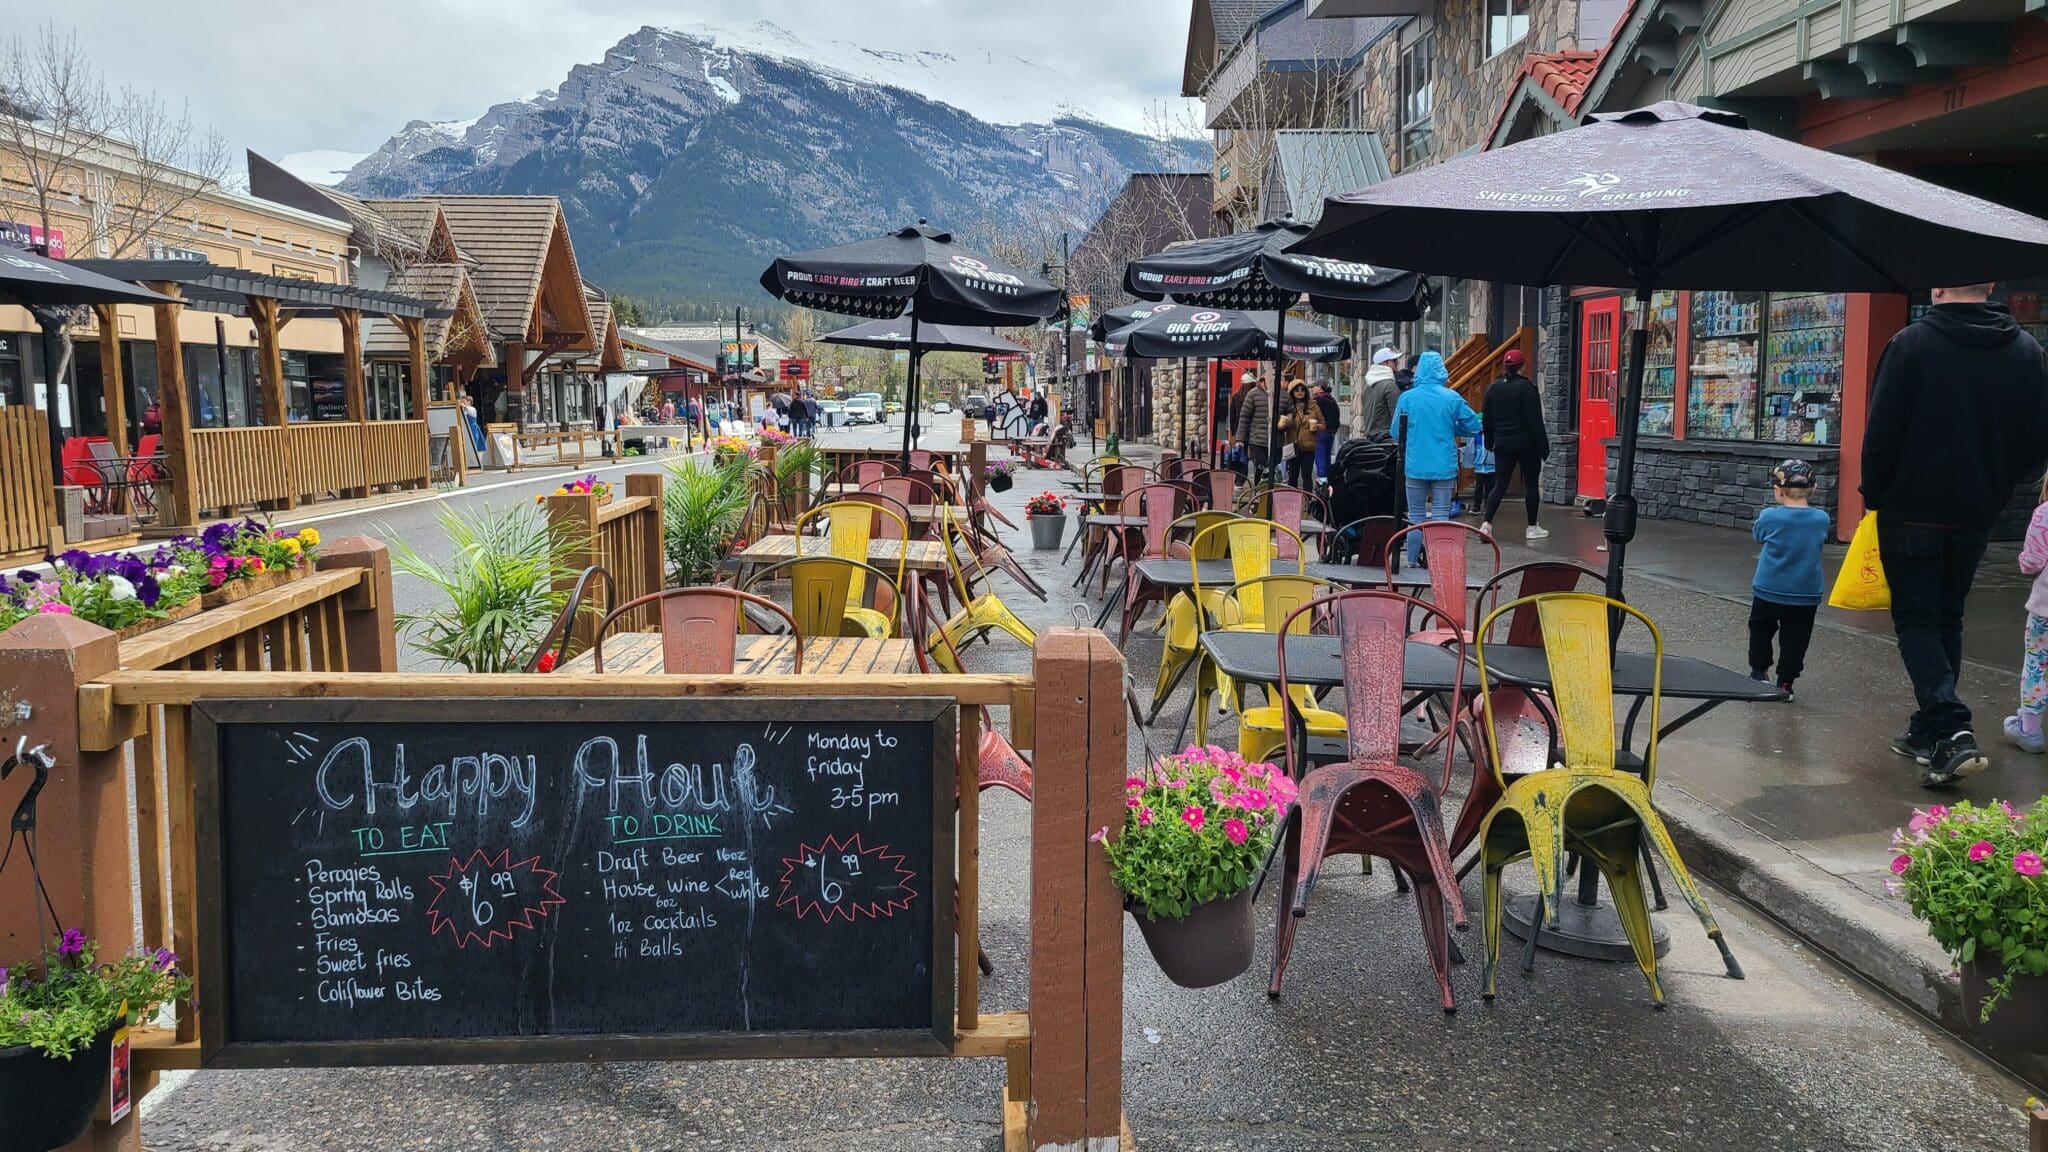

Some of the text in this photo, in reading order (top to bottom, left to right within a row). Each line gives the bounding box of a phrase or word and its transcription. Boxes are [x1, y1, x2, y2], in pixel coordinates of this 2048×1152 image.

[1474, 188, 1692, 202] SHEEPDOG BREWING
[787, 271, 814, 282] PROUD
[815, 274, 838, 285] EARLY
[839, 276, 859, 287] BIRD
[866, 276, 892, 287] CRAFT
[894, 275, 916, 286] BEER
[1139, 271, 1163, 282] PROUD
[1164, 274, 1187, 284] EARLY
[1188, 276, 1207, 285] BIRD
[1232, 266, 1249, 279] BEER
[1307, 267, 1368, 283] BREWERY
[1324, 262, 1375, 276] ROCK
[965, 279, 1018, 296] BREWERY
[1130, 310, 1152, 319] BIG
[1166, 321, 1231, 334] BIG ROCK
[1171, 334, 1221, 342] BREWERY
[808, 729, 897, 758] Monday to
[316, 734, 774, 828] Happy Hour
[830, 787, 898, 821] 3-5 pm
[605, 813, 721, 836] TO DRINK
[351, 822, 453, 850] TO EAT
[598, 846, 747, 880] Draft Beer 16oz
[730, 866, 752, 881] Red
[305, 859, 380, 890] Perogies
[308, 877, 414, 915] Spring Rolls
[603, 878, 657, 899] House
[656, 896, 678, 908] 6oz
[311, 907, 400, 929] Samosas
[609, 906, 717, 935] 1oz Cocktails
[316, 932, 358, 952] Fries
[614, 932, 683, 958] Hi Balls
[317, 950, 366, 974] Sweet
[318, 976, 442, 1008] Coliflower Bites
